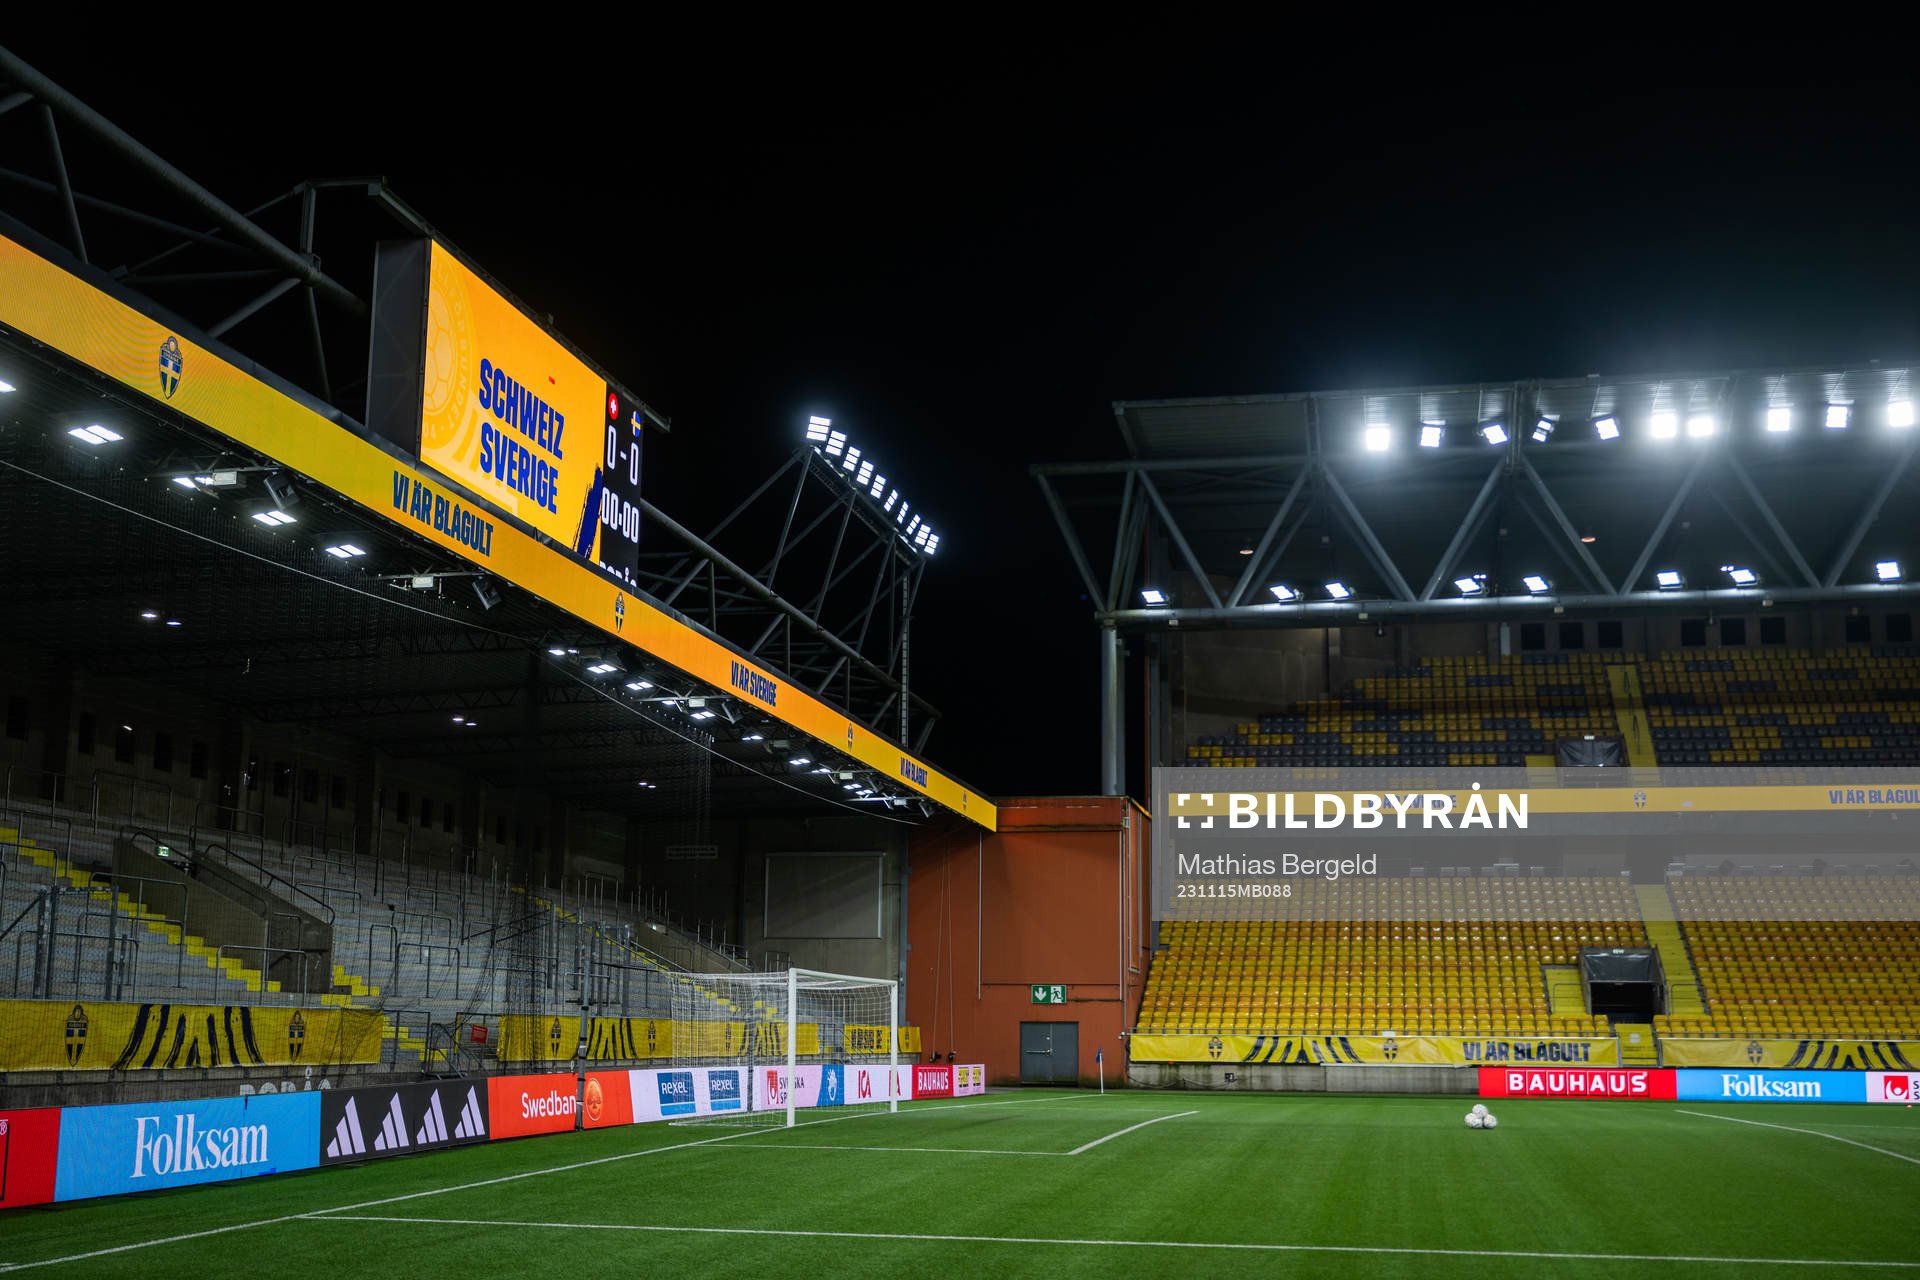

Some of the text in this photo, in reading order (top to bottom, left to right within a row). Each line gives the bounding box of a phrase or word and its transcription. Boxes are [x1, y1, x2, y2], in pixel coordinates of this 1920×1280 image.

[479, 358, 565, 461] SCHWEIZ
[480, 422, 559, 515] SVERIGE
[607, 424, 617, 470] 0
[630, 442, 639, 486] 0
[393, 470, 494, 557] VI ÄR BLÅGULT
[601, 486, 640, 543] 00:00
[731, 660, 739, 687] VI
[750, 671, 777, 707] SVERIGE
[1829, 790, 1843, 804] VI
[1846, 789, 1866, 804] ÄR
[1462, 1041, 1591, 1062] VI ÄR BLÅGULT
[858, 1070, 872, 1099] ICA
[918, 1071, 949, 1091] BAUHAUS
[1509, 1073, 1647, 1093] BAUHAUS
[1721, 1074, 1822, 1098] Folksam
[521, 1090, 578, 1118] Swedban
[129, 1113, 269, 1179] Folksam
